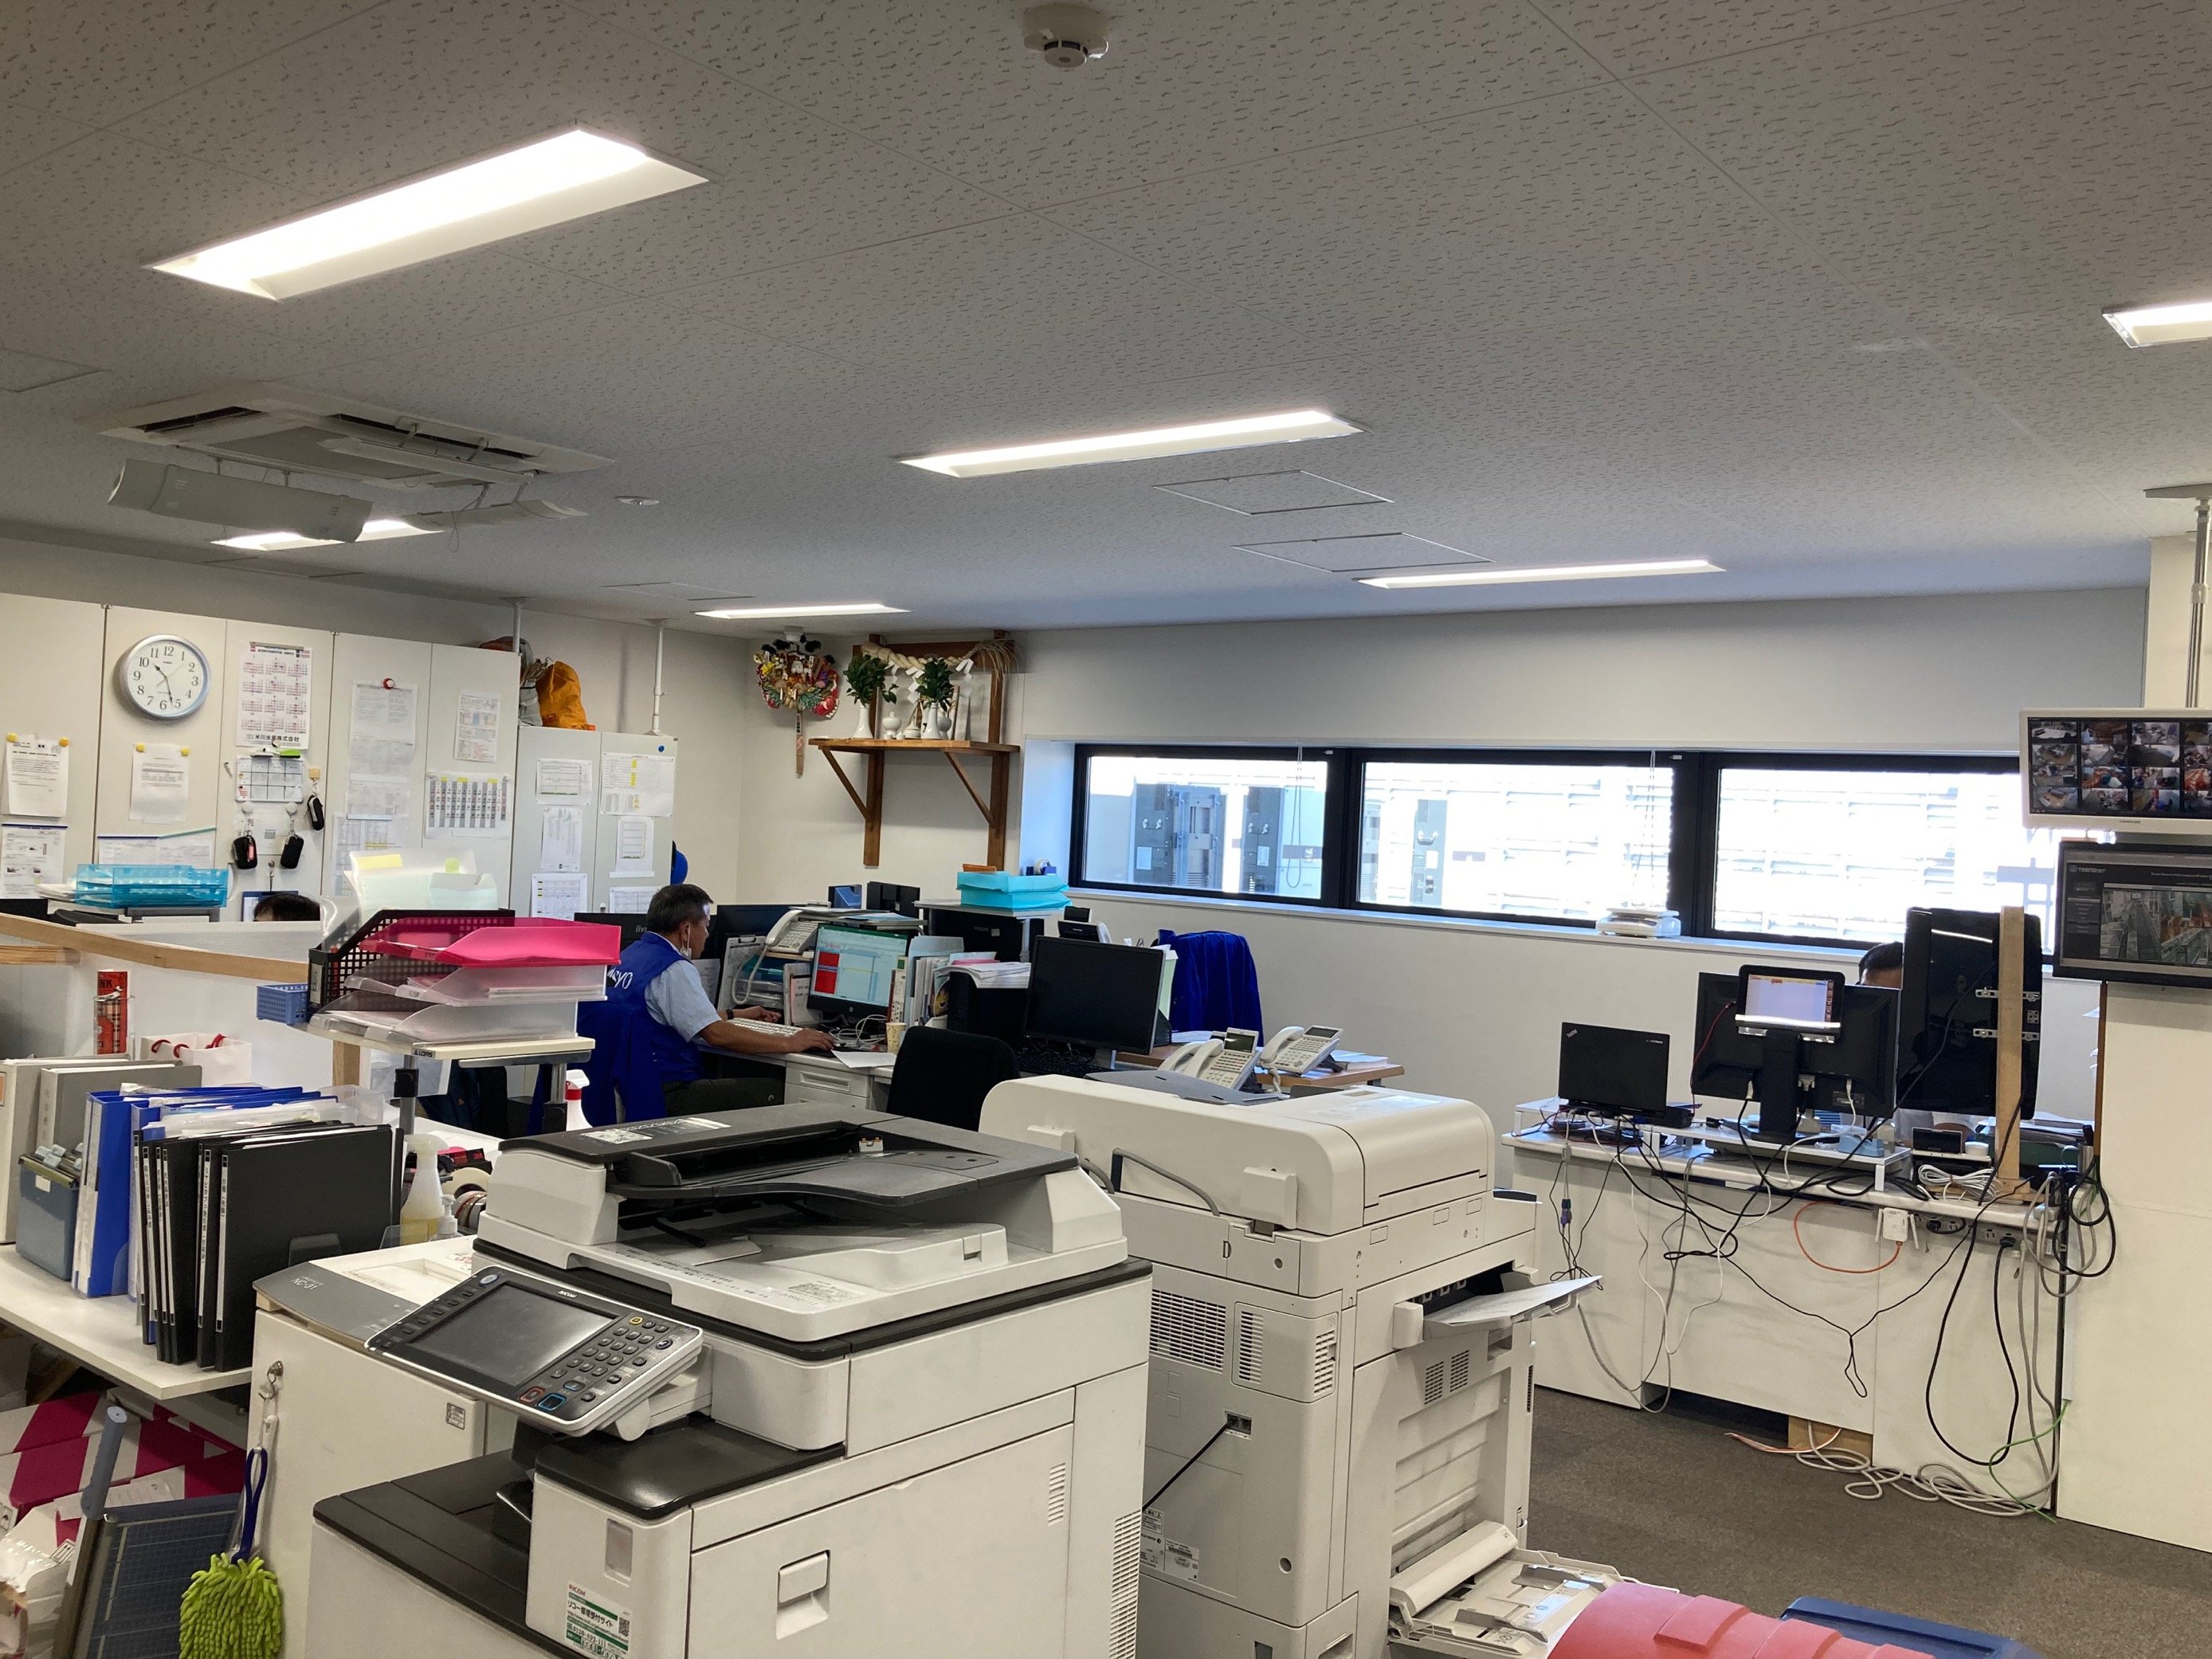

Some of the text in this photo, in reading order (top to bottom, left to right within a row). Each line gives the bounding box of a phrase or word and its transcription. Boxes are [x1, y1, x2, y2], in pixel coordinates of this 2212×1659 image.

[150, 648, 159, 658] 11
[163, 646, 175, 657] 12
[181, 651, 185, 661] 1
[139, 657, 149, 667] 10
[188, 662, 195, 672] 2
[133, 671, 141, 680] 9
[191, 676, 198, 686] 3
[137, 685, 144, 695] 8
[185, 689, 191, 699] 4
[147, 696, 155, 705] 7
[159, 700, 167, 710] 6
[175, 699, 181, 708] 5
[568, 1584, 586, 1597] RICOH
